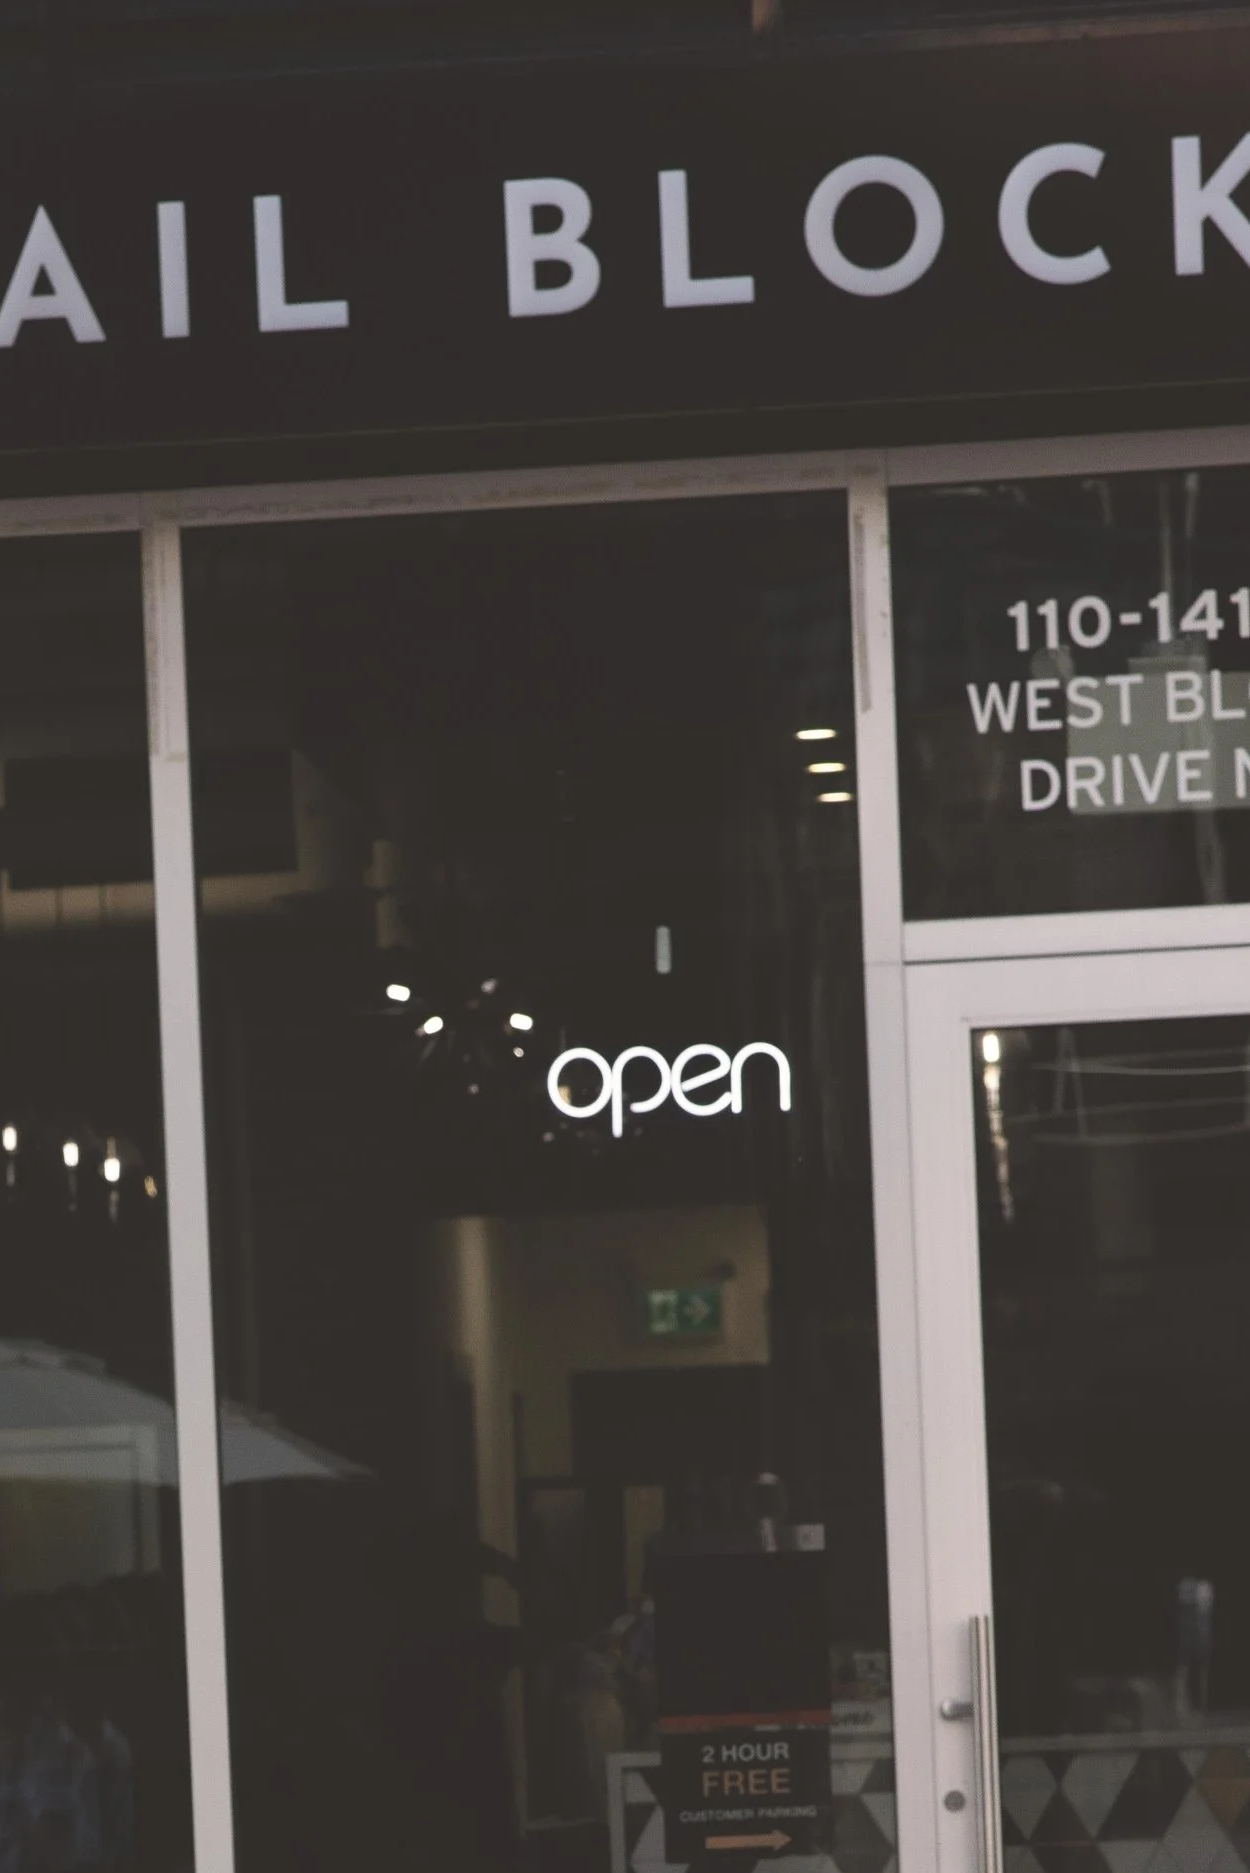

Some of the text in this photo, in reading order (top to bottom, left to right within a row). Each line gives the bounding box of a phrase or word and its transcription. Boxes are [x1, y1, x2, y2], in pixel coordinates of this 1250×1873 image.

[502, 132, 1250, 318] BLOCK
[1006, 587, 1250, 652] 110-141
[966, 669, 1250, 734] WEST BL
[1020, 748, 1215, 811] DRIVE
[546, 1041, 792, 1139] open
[701, 1740, 791, 1764] 2 HOUR
[701, 1768, 792, 1799] FREE
[678, 1804, 818, 1824] CUSTOMER PARKING
